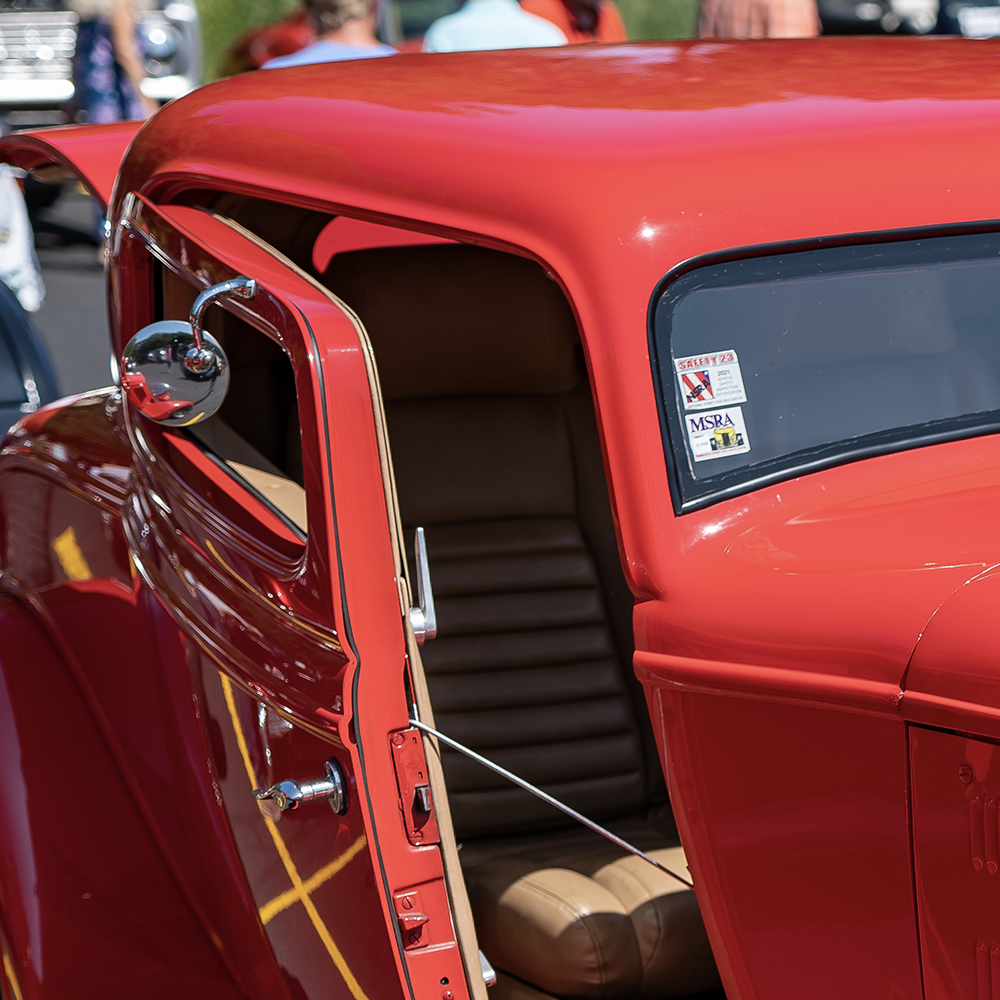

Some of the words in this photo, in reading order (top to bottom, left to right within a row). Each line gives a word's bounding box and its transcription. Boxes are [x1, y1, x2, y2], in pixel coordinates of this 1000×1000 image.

[678, 355, 716, 370] SAFETY
[719, 352, 734, 363] 23
[686, 380, 711, 402] NSRA
[689, 412, 735, 433] MSRA
